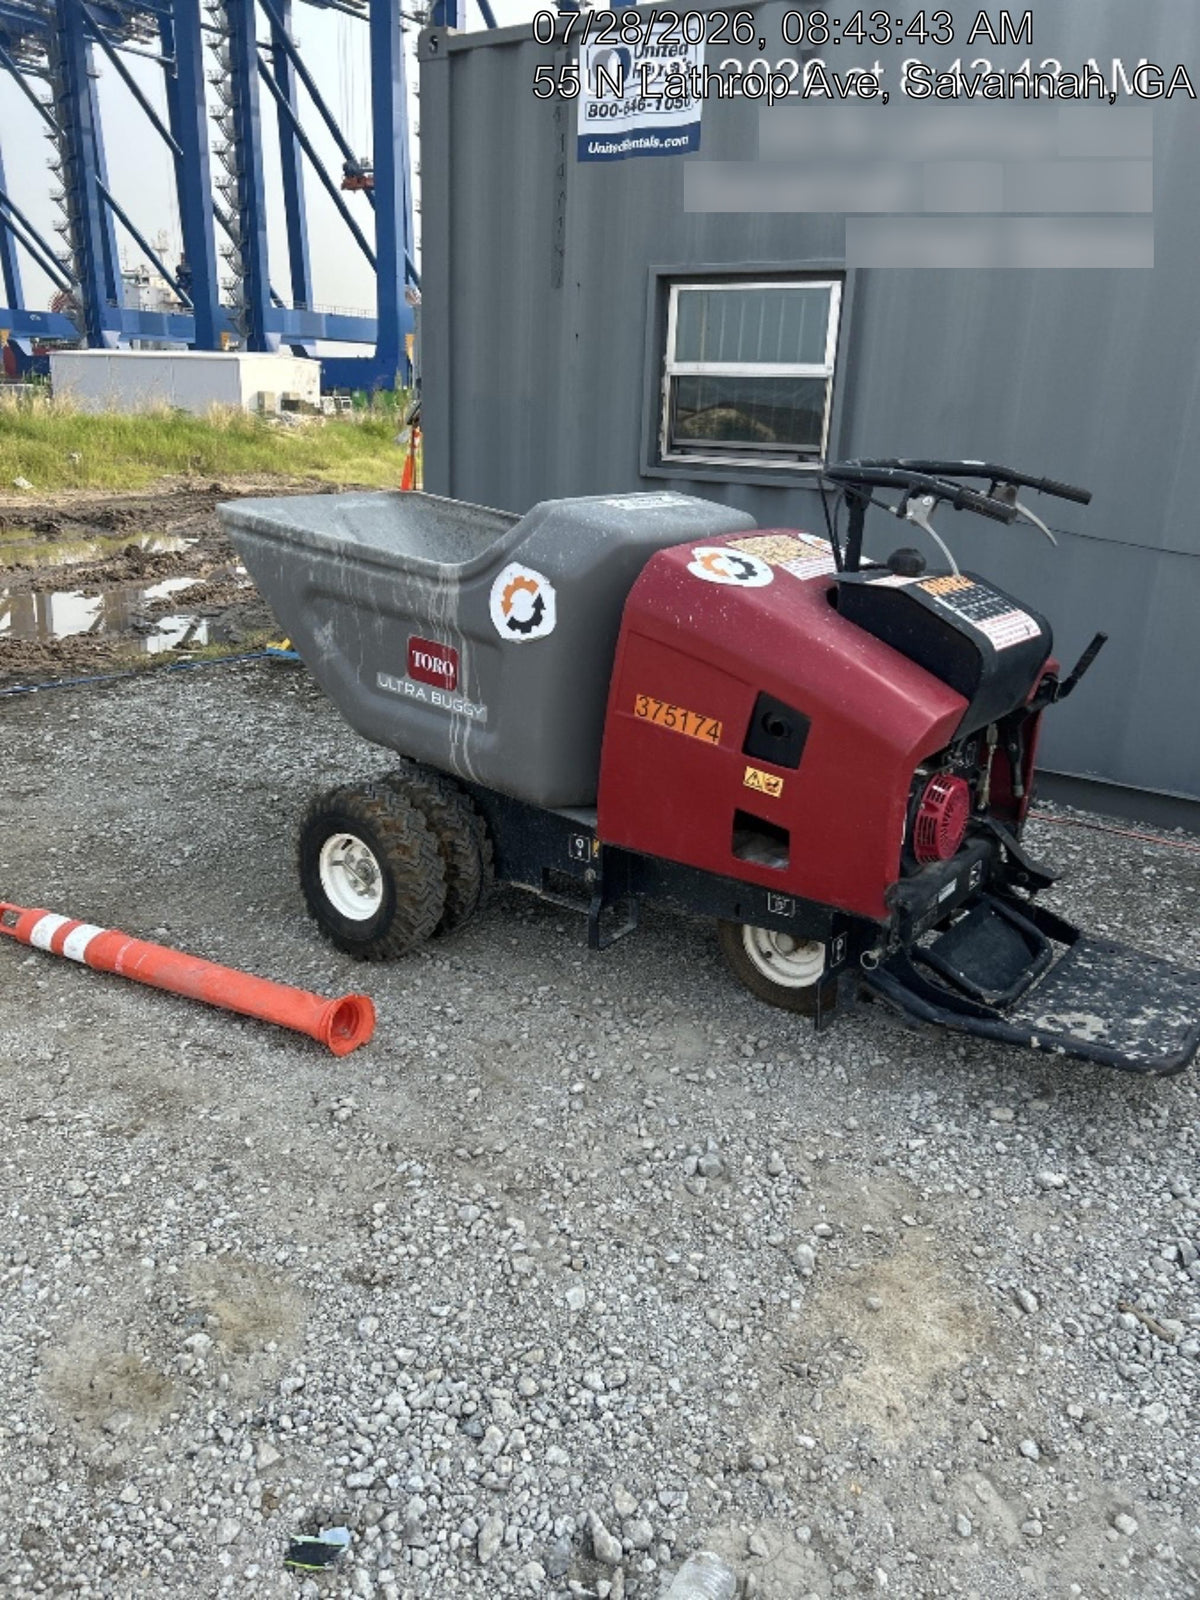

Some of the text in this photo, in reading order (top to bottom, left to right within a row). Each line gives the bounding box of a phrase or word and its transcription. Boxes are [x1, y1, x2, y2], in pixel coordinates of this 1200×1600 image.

[634, 41, 689, 59] United
[412, 650, 455, 677] TORO
[377, 674, 486, 716] ULTRA BUGGY
[636, 697, 720, 742] 375174
